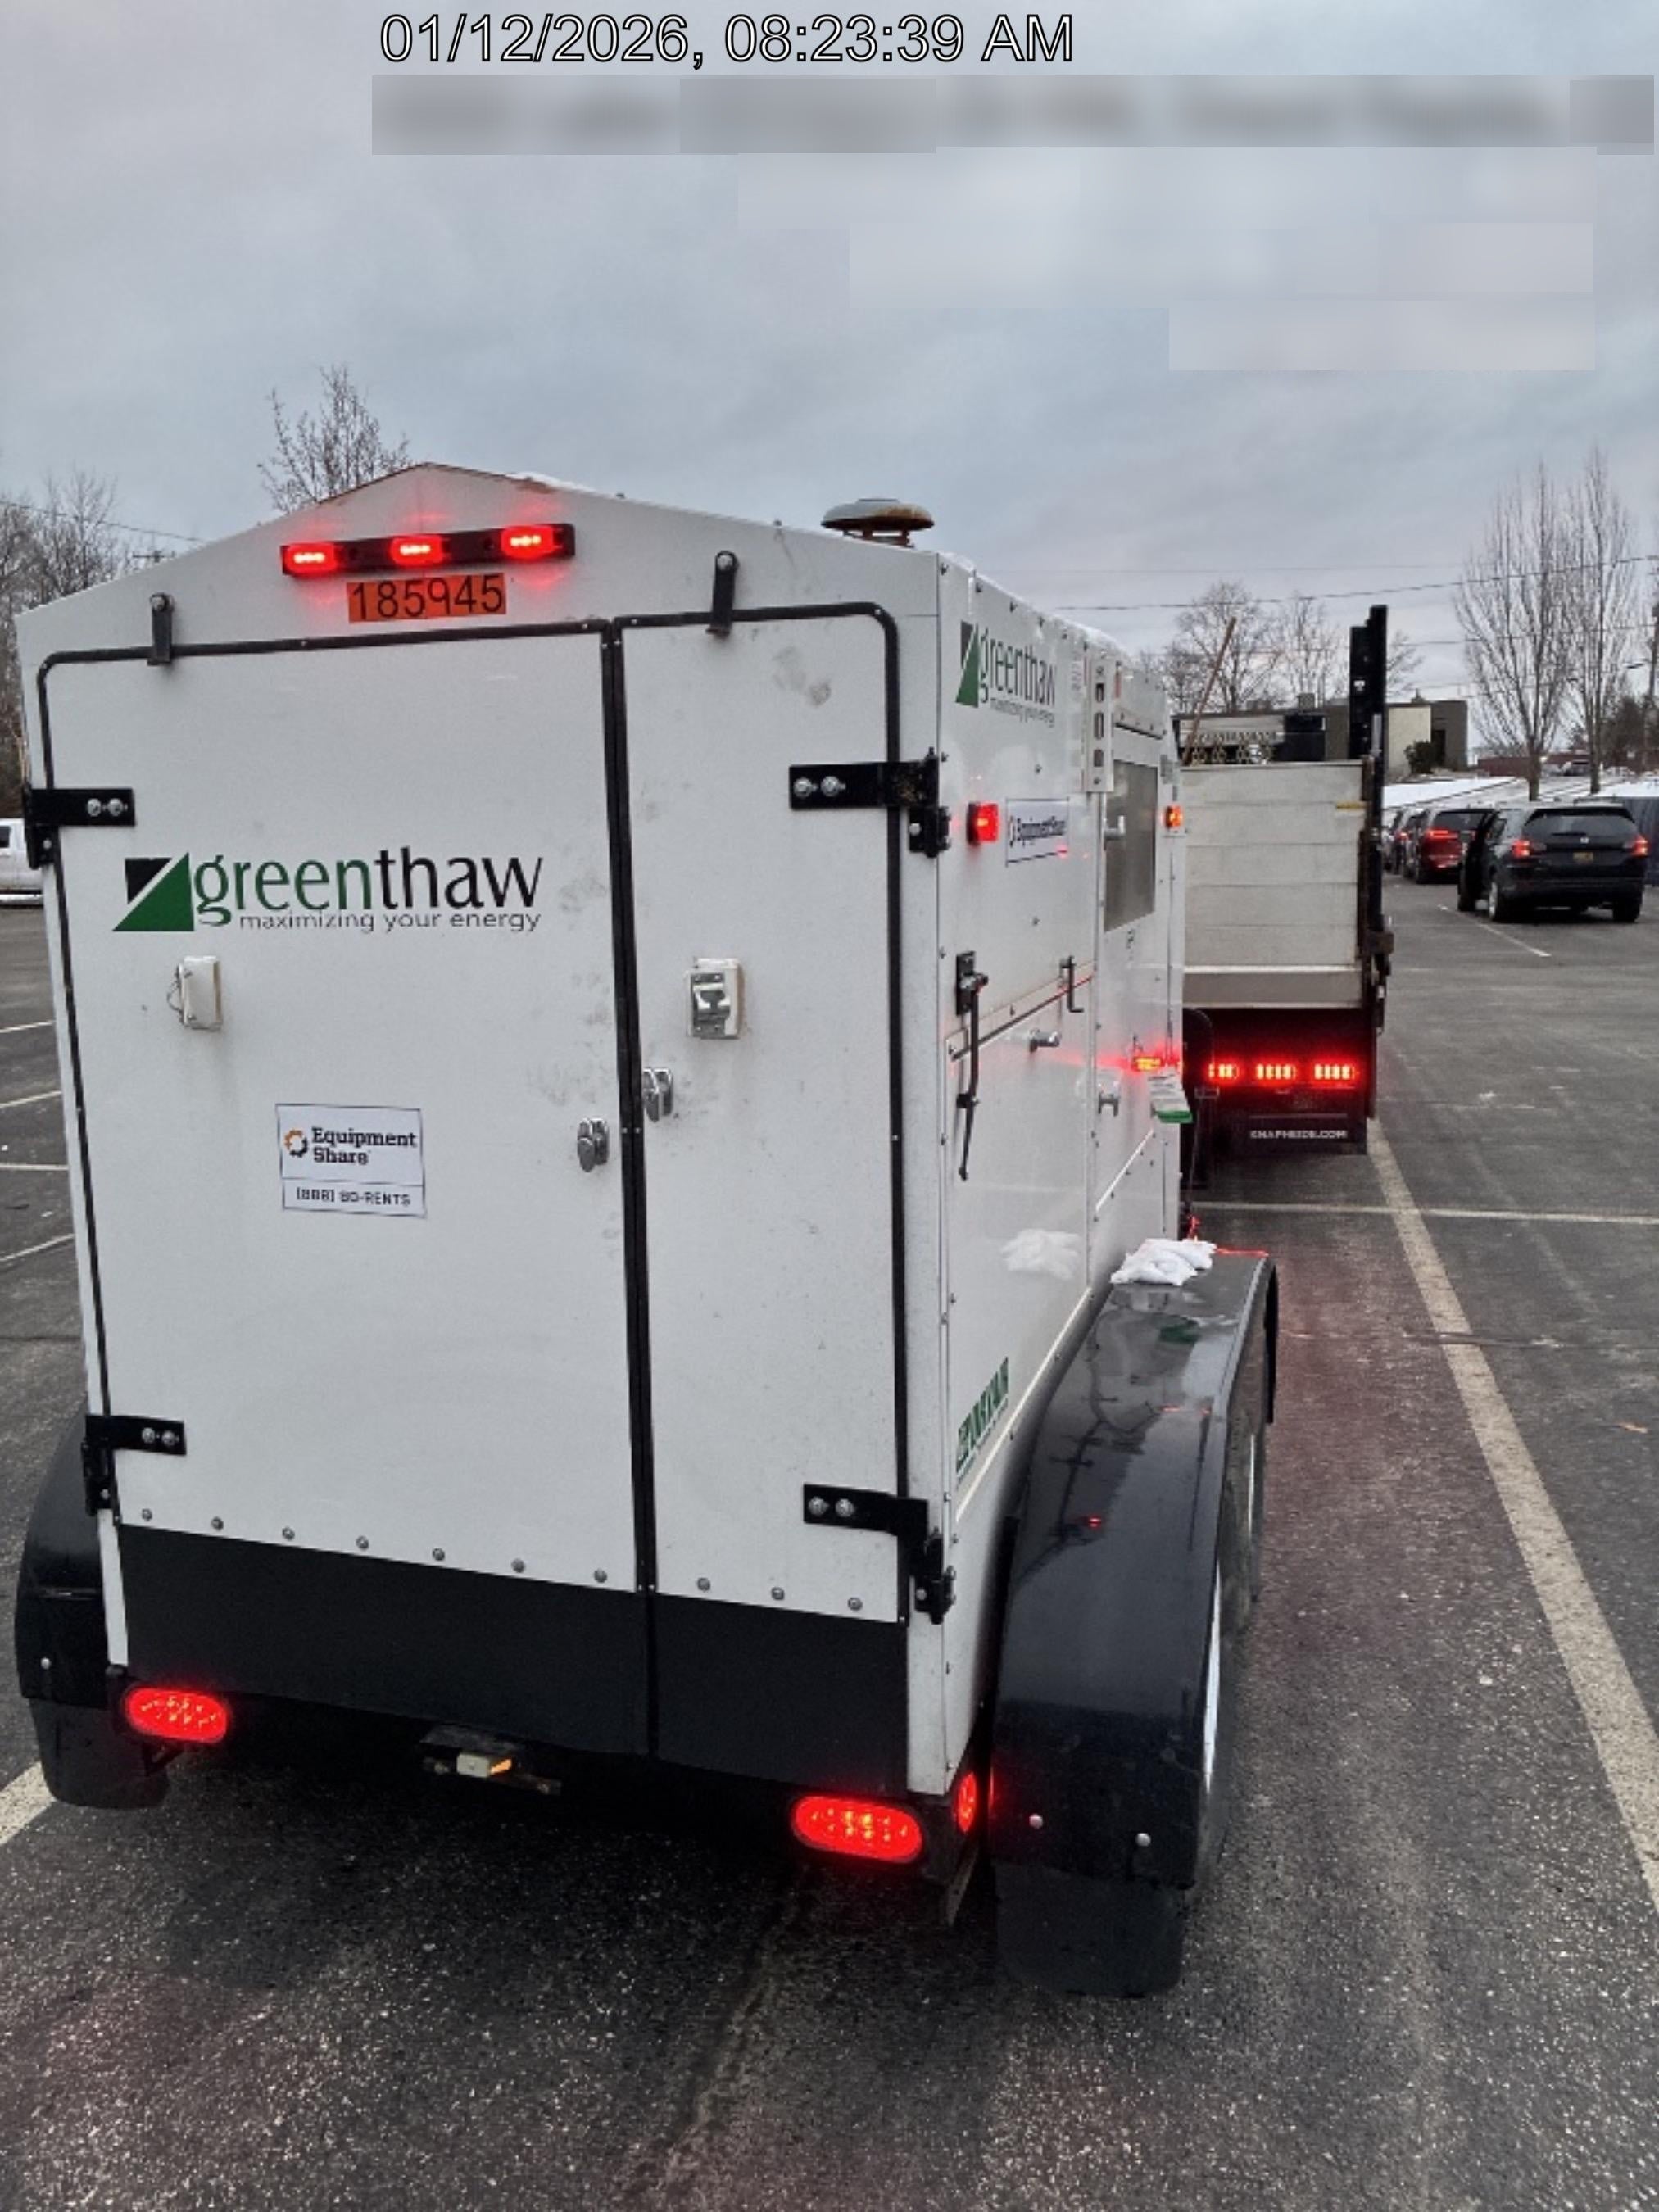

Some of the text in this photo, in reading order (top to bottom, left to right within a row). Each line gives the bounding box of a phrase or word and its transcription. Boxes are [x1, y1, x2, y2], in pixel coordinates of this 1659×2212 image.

[352, 575, 503, 620] 185945
[979, 627, 1057, 708] greenthaw
[193, 845, 544, 927] greenthaw
[239, 910, 542, 933] maximizing your energy
[311, 1126, 418, 1148] Equipment
[313, 1146, 369, 1165] Share
